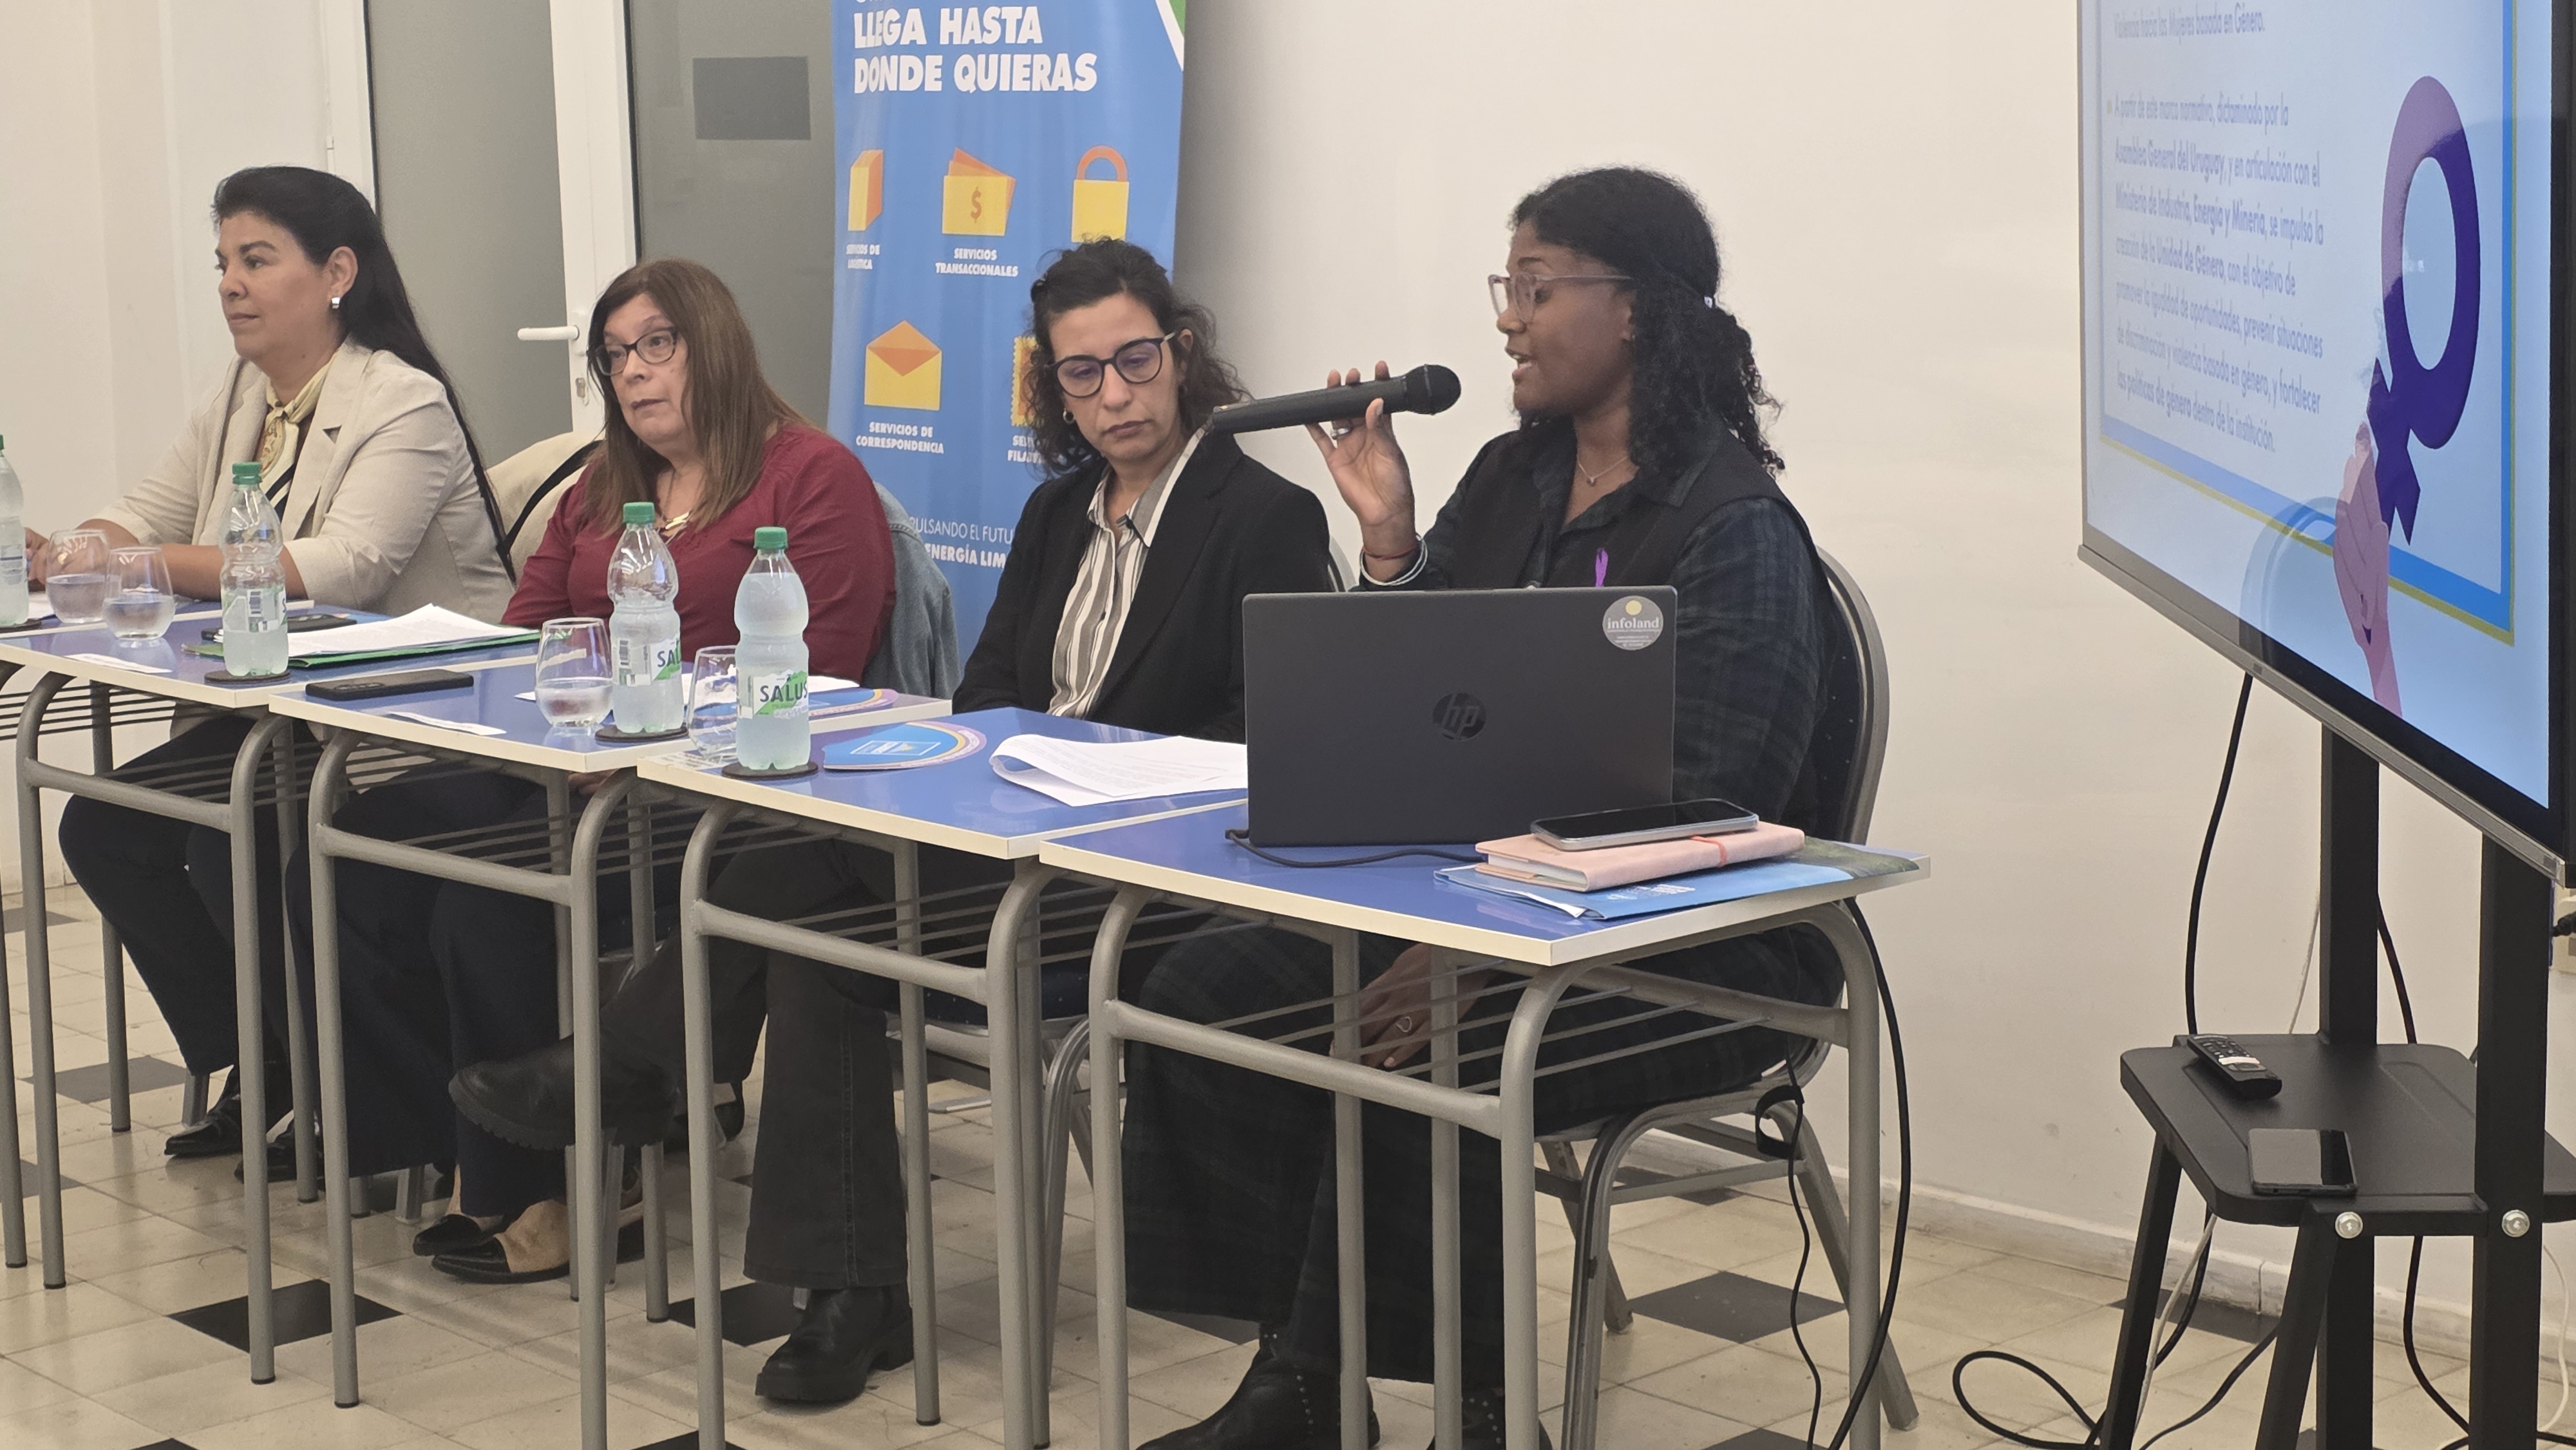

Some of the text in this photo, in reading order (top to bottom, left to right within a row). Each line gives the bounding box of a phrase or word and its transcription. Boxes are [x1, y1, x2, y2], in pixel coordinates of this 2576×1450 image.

[854, 6, 1043, 48] LLEGA HASTA
[2169, 6, 2194, 45] Mujeres
[2224, 14, 2233, 34] en
[2235, 2, 2266, 34] Género.
[854, 53, 1097, 94] DONDE QUIERAS
[2115, 91, 2119, 117] A
[2137, 90, 2145, 118] de
[2146, 95, 2157, 119] este
[2159, 101, 2178, 120] marco
[2217, 90, 2262, 125] dictaminado
[2265, 105, 2278, 136] por
[2280, 91, 2288, 126] la
[2148, 139, 2176, 170] General
[2177, 139, 2188, 171] del
[2190, 142, 2226, 185] Uruguay,
[2228, 157, 2233, 186] y
[2235, 157, 2244, 177] en
[2246, 146, 2292, 183] articulación
[2294, 162, 2309, 185] con
[2312, 150, 2320, 187] el
[2148, 185, 2157, 216] de
[2193, 193, 2223, 235] Energía
[2224, 207, 2230, 238] y
[2232, 198, 2267, 241] Minería,
[2269, 216, 2278, 238] se
[2280, 207, 2313, 250] impulsó
[2315, 209, 2324, 245] la
[869, 244, 880, 255] DE
[935, 262, 1019, 278] TRANSACCIONALES
[954, 248, 998, 261] SERVICIOS
[2141, 231, 2148, 261] de
[2149, 231, 2155, 263] la
[2157, 236, 2183, 269] Unidad
[2184, 239, 2193, 272] de
[2195, 244, 2226, 285] Género,
[2228, 262, 2241, 284] con
[2242, 252, 2249, 286] el
[2251, 254, 2283, 299] objetivo
[2285, 261, 2295, 296] de
[2144, 278, 2150, 308] la
[2152, 282, 2179, 318] igualdad
[2181, 287, 2188, 319] de
[2190, 296, 2242, 341] oportunidades,
[2244, 314, 2275, 346] prevenir
[2277, 316, 2323, 359] situaciones
[2117, 315, 2124, 345] de
[2166, 344, 2171, 371] y
[2173, 336, 2201, 373] violencia
[2231, 364, 2239, 386] en
[2241, 361, 2271, 404] género,
[2272, 379, 2277, 410] y
[2279, 368, 2320, 415] fortalecer
[2117, 361, 2275, 453] las políticas de género dentro de la institución.
[856, 435, 944, 455] CORRESPONDENCIA
[869, 421, 933, 438] SERVICIOS DE
[909, 516, 1013, 545] PULSANDO EL FUTU
[980, 550, 1006, 569] LIM
[1607, 617, 1660, 629] infoland
[657, 649, 680, 668] SAL
[760, 681, 808, 702] SALUS
[1440, 693, 1481, 740] hp
